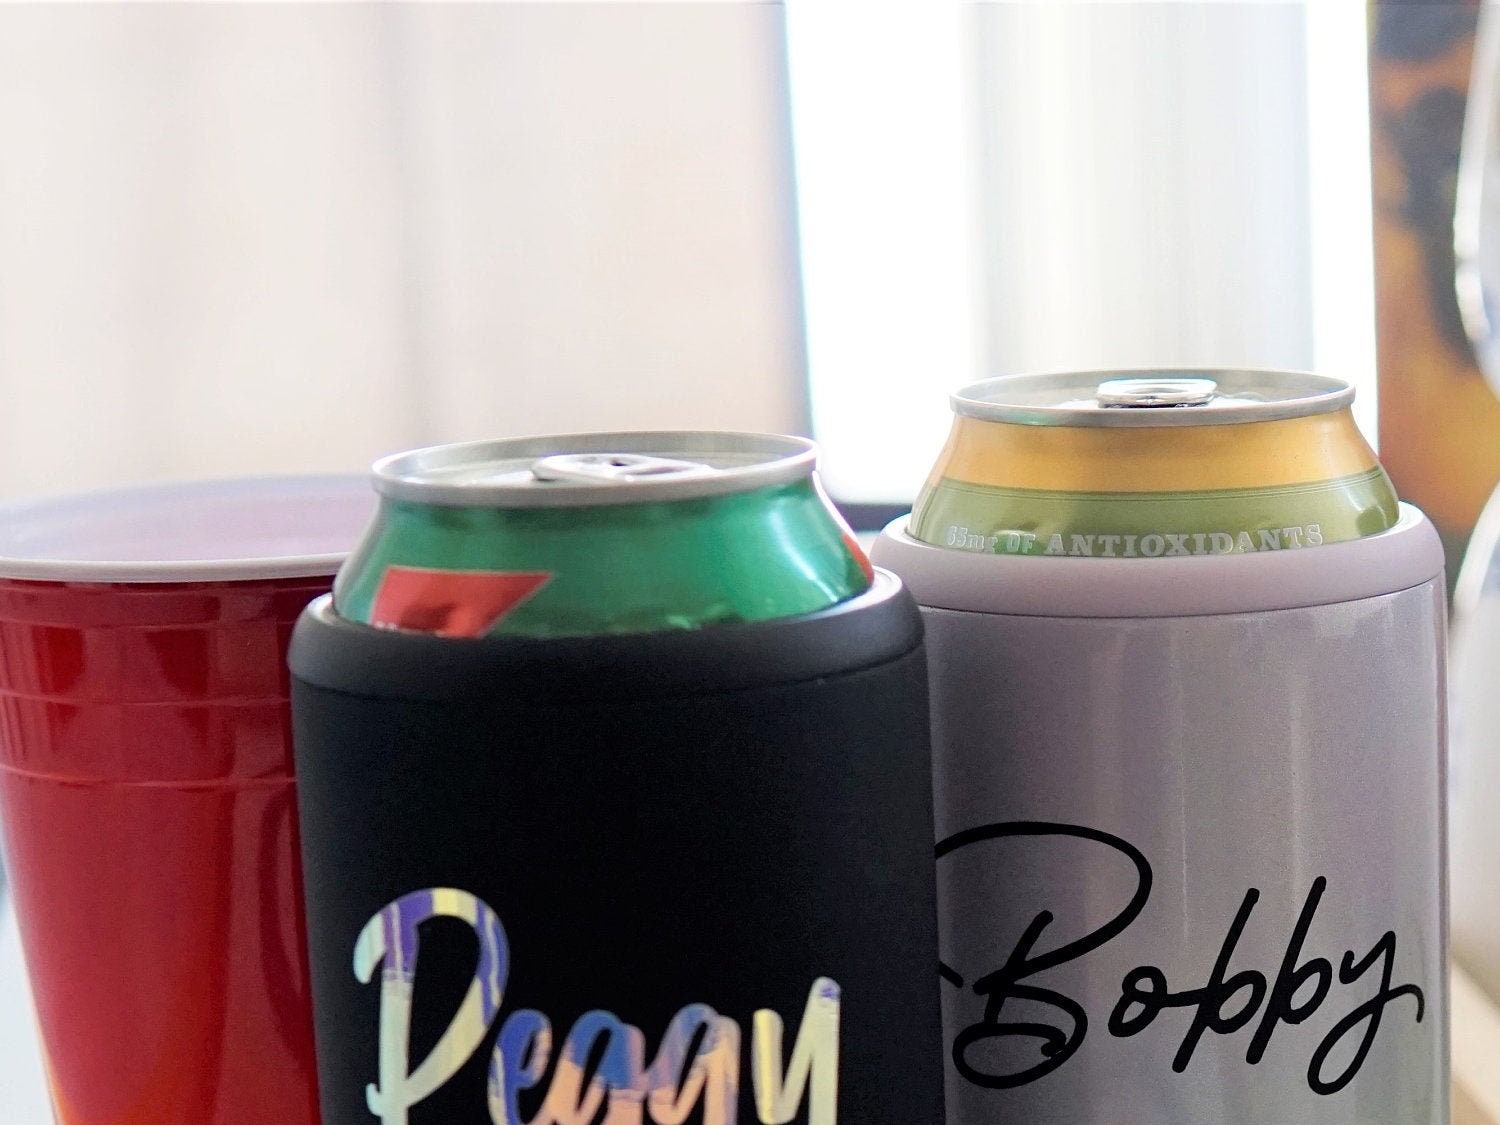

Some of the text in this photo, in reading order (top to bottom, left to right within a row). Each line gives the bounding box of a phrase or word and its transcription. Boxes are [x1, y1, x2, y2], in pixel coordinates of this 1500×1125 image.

[1005, 532, 1036, 553] OF
[1043, 524, 1324, 559] ANTIOXIDANTS
[935, 821, 1425, 1096] Bobby
